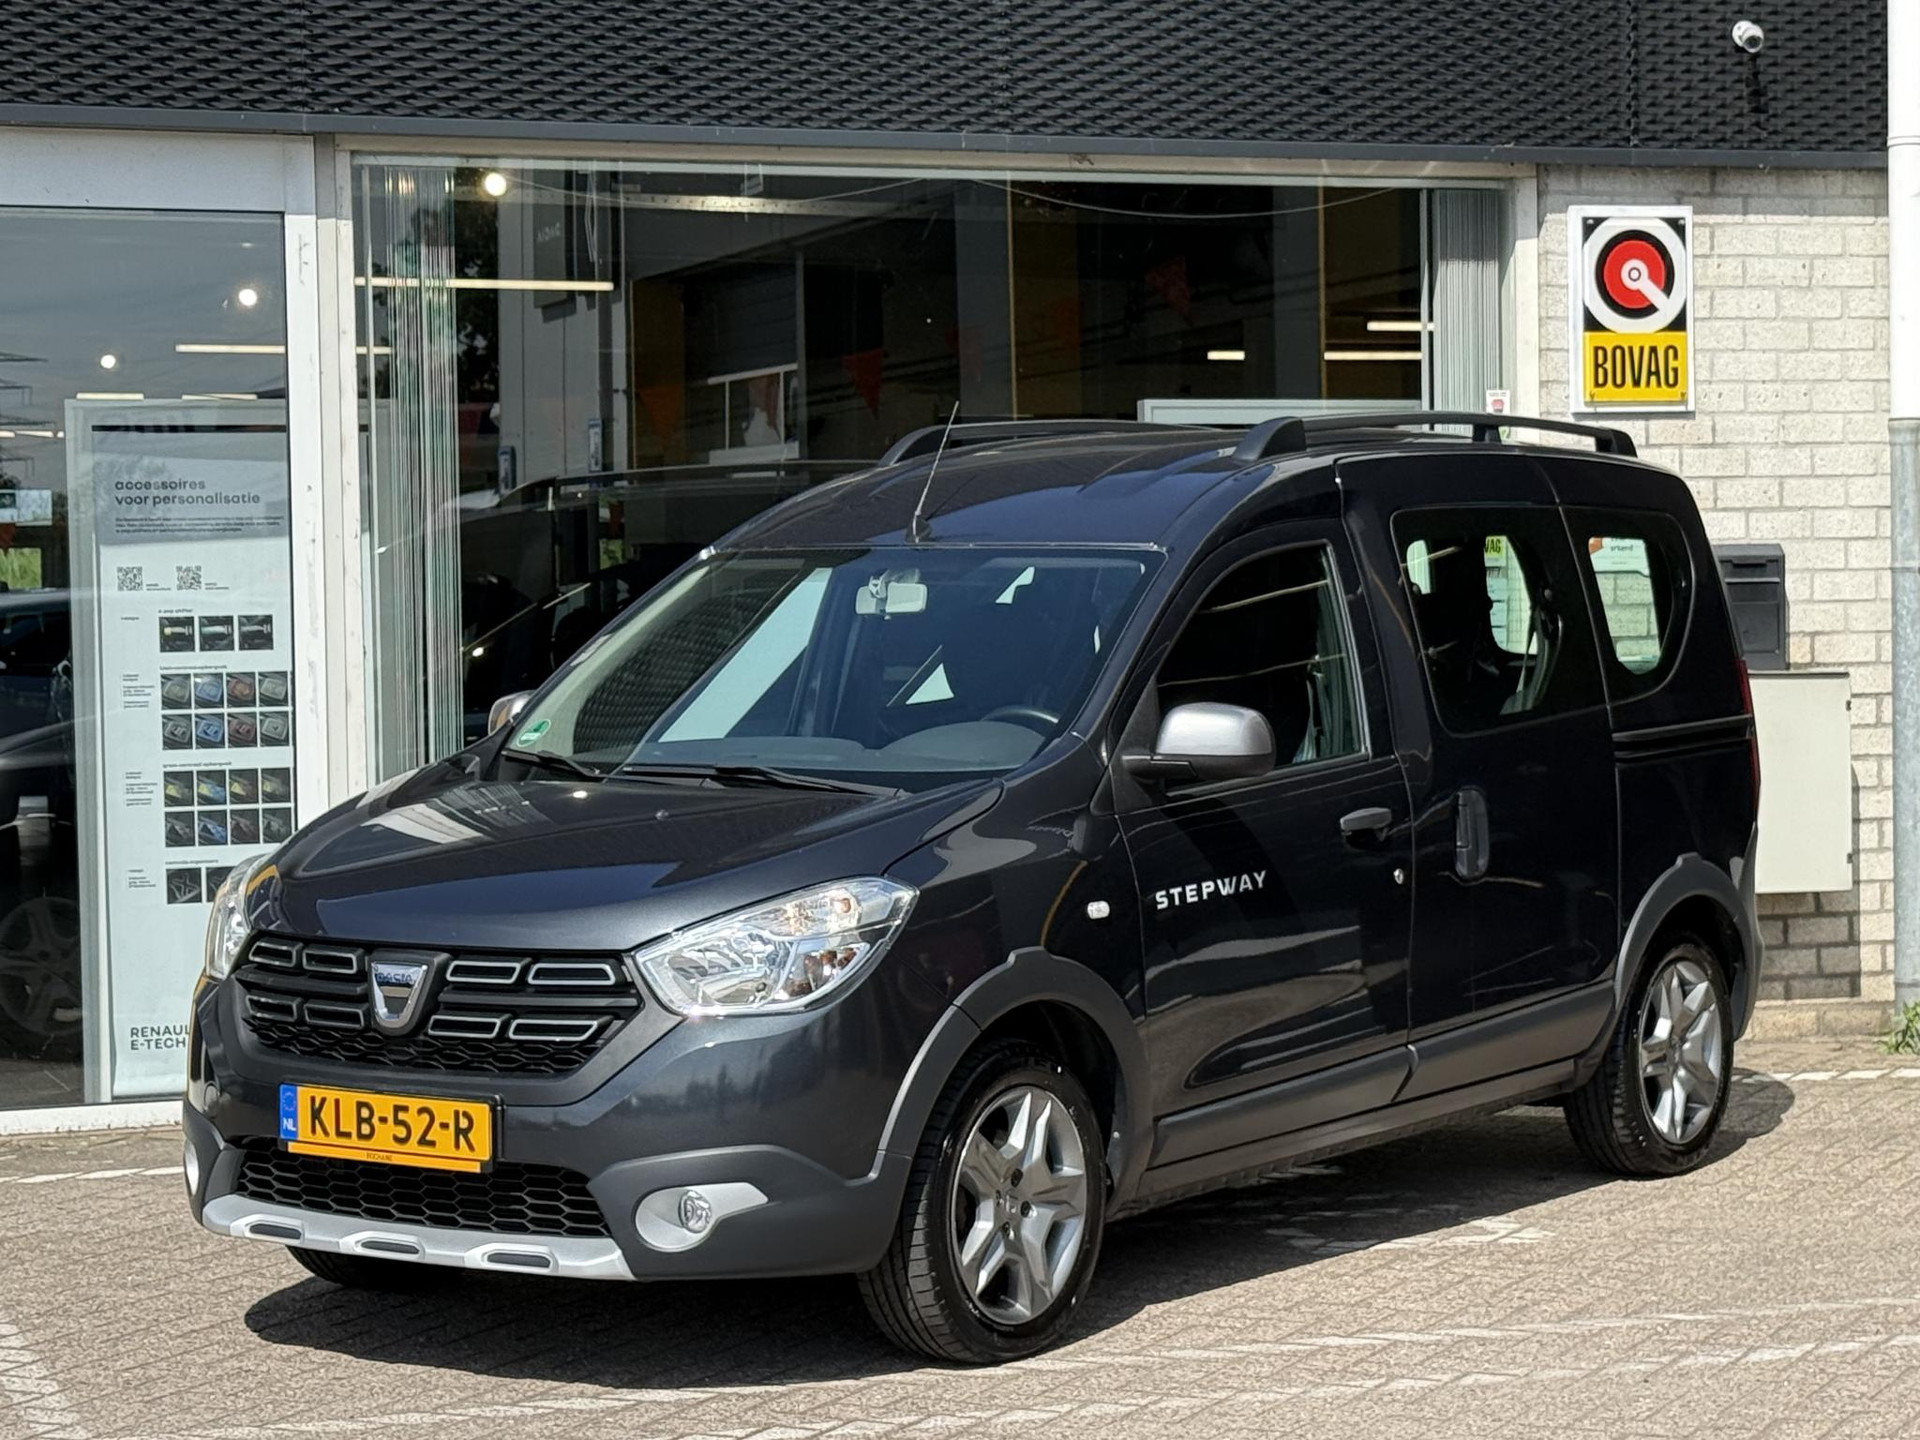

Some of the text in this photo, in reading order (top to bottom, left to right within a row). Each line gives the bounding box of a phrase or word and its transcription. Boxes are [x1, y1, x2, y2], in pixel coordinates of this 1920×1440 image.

[1592, 344, 1679, 389] BOVAG
[114, 478, 206, 491] accessoires
[114, 491, 261, 507] voor personalisatie
[1155, 869, 1267, 910] STEPWAY
[130, 1037, 186, 1050] E-TECH
[282, 1117, 297, 1132] NL
[309, 1094, 476, 1153] KLB-52-R
